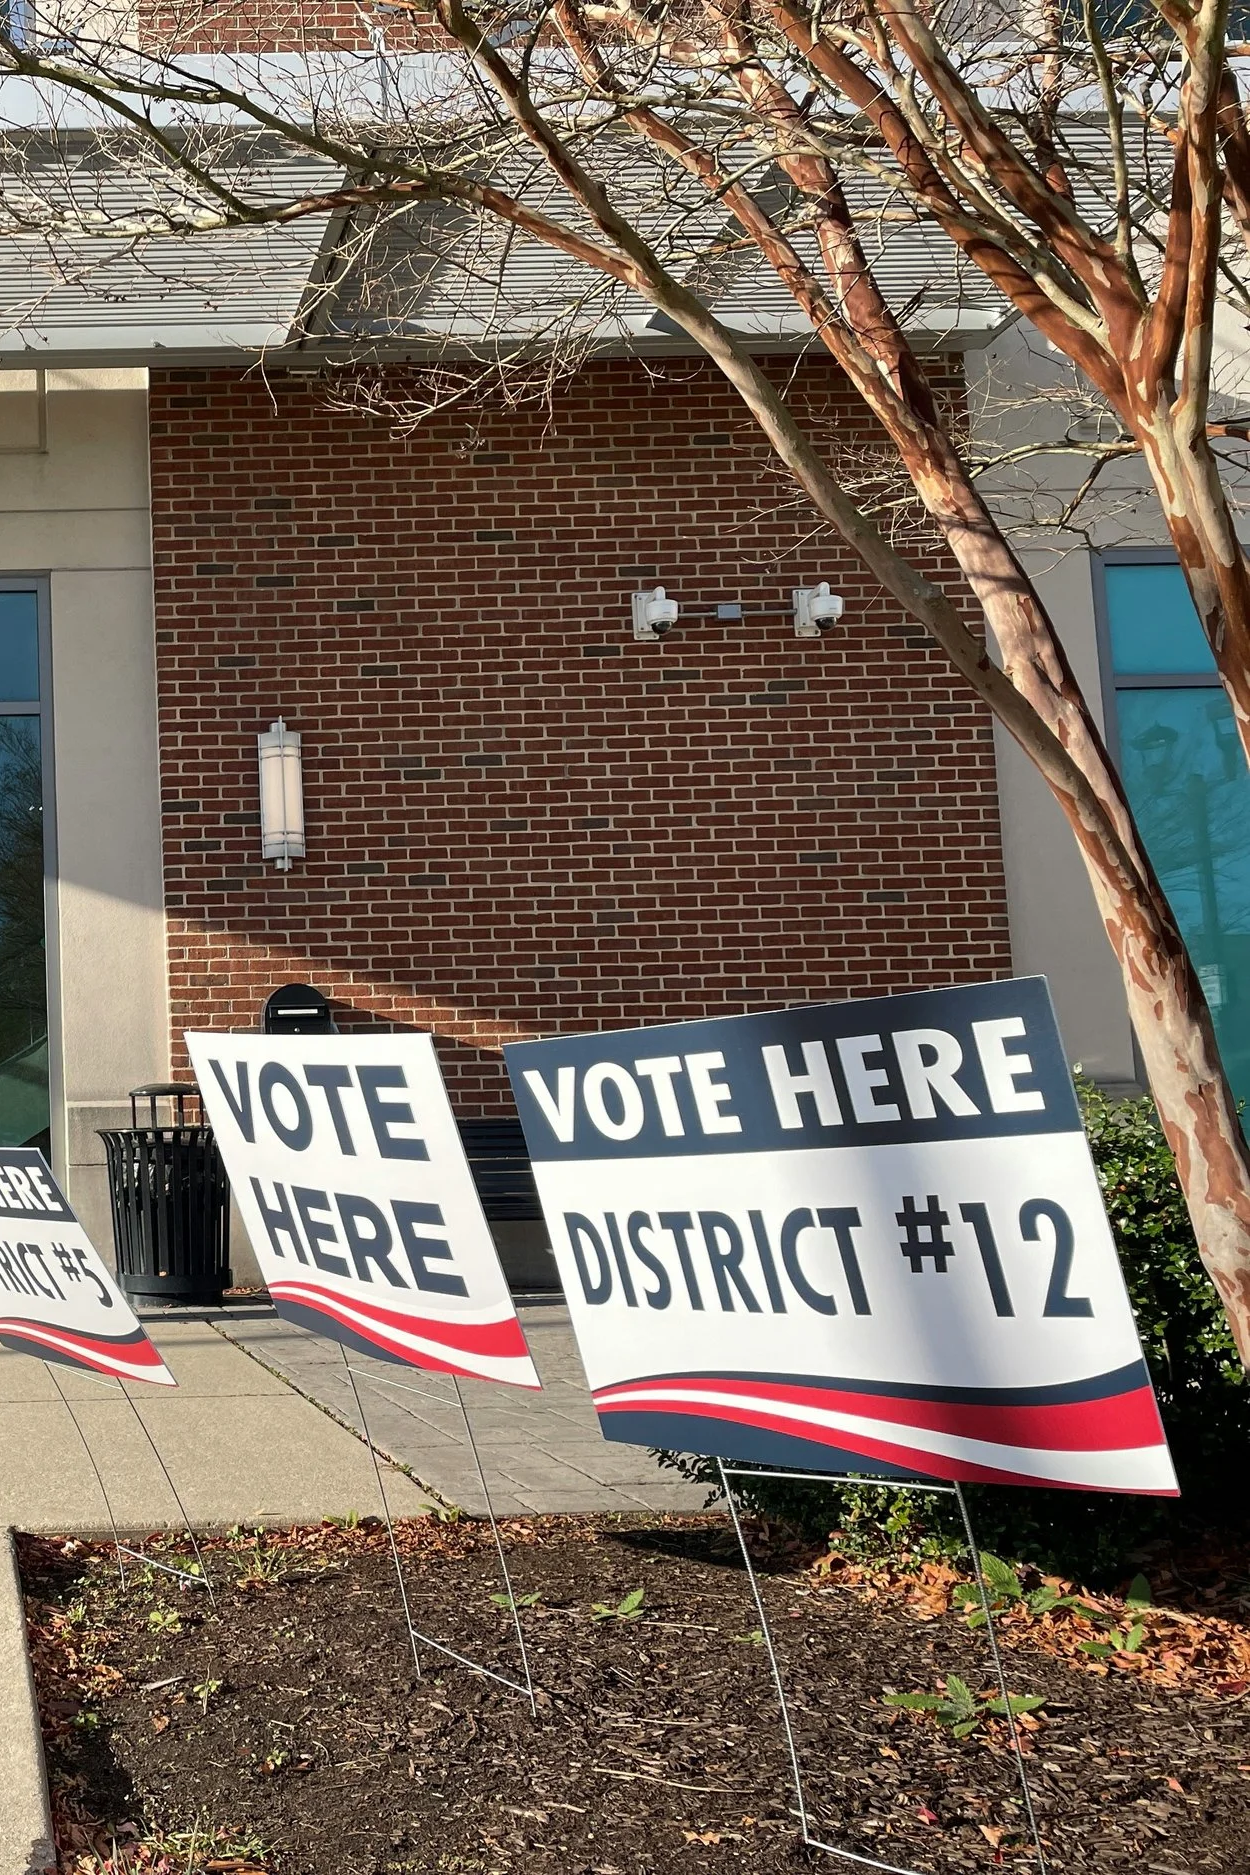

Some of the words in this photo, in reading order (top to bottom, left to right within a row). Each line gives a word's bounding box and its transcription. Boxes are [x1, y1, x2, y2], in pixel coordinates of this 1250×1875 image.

[208, 1059, 431, 1162] VOTE
[523, 1051, 742, 1142] VOTE
[761, 1016, 1046, 1129] HERE
[52, 1242, 113, 1309] #5
[249, 1176, 470, 1298] HERE
[563, 1206, 873, 1316] DISTRICT
[895, 1194, 1095, 1318] #12
